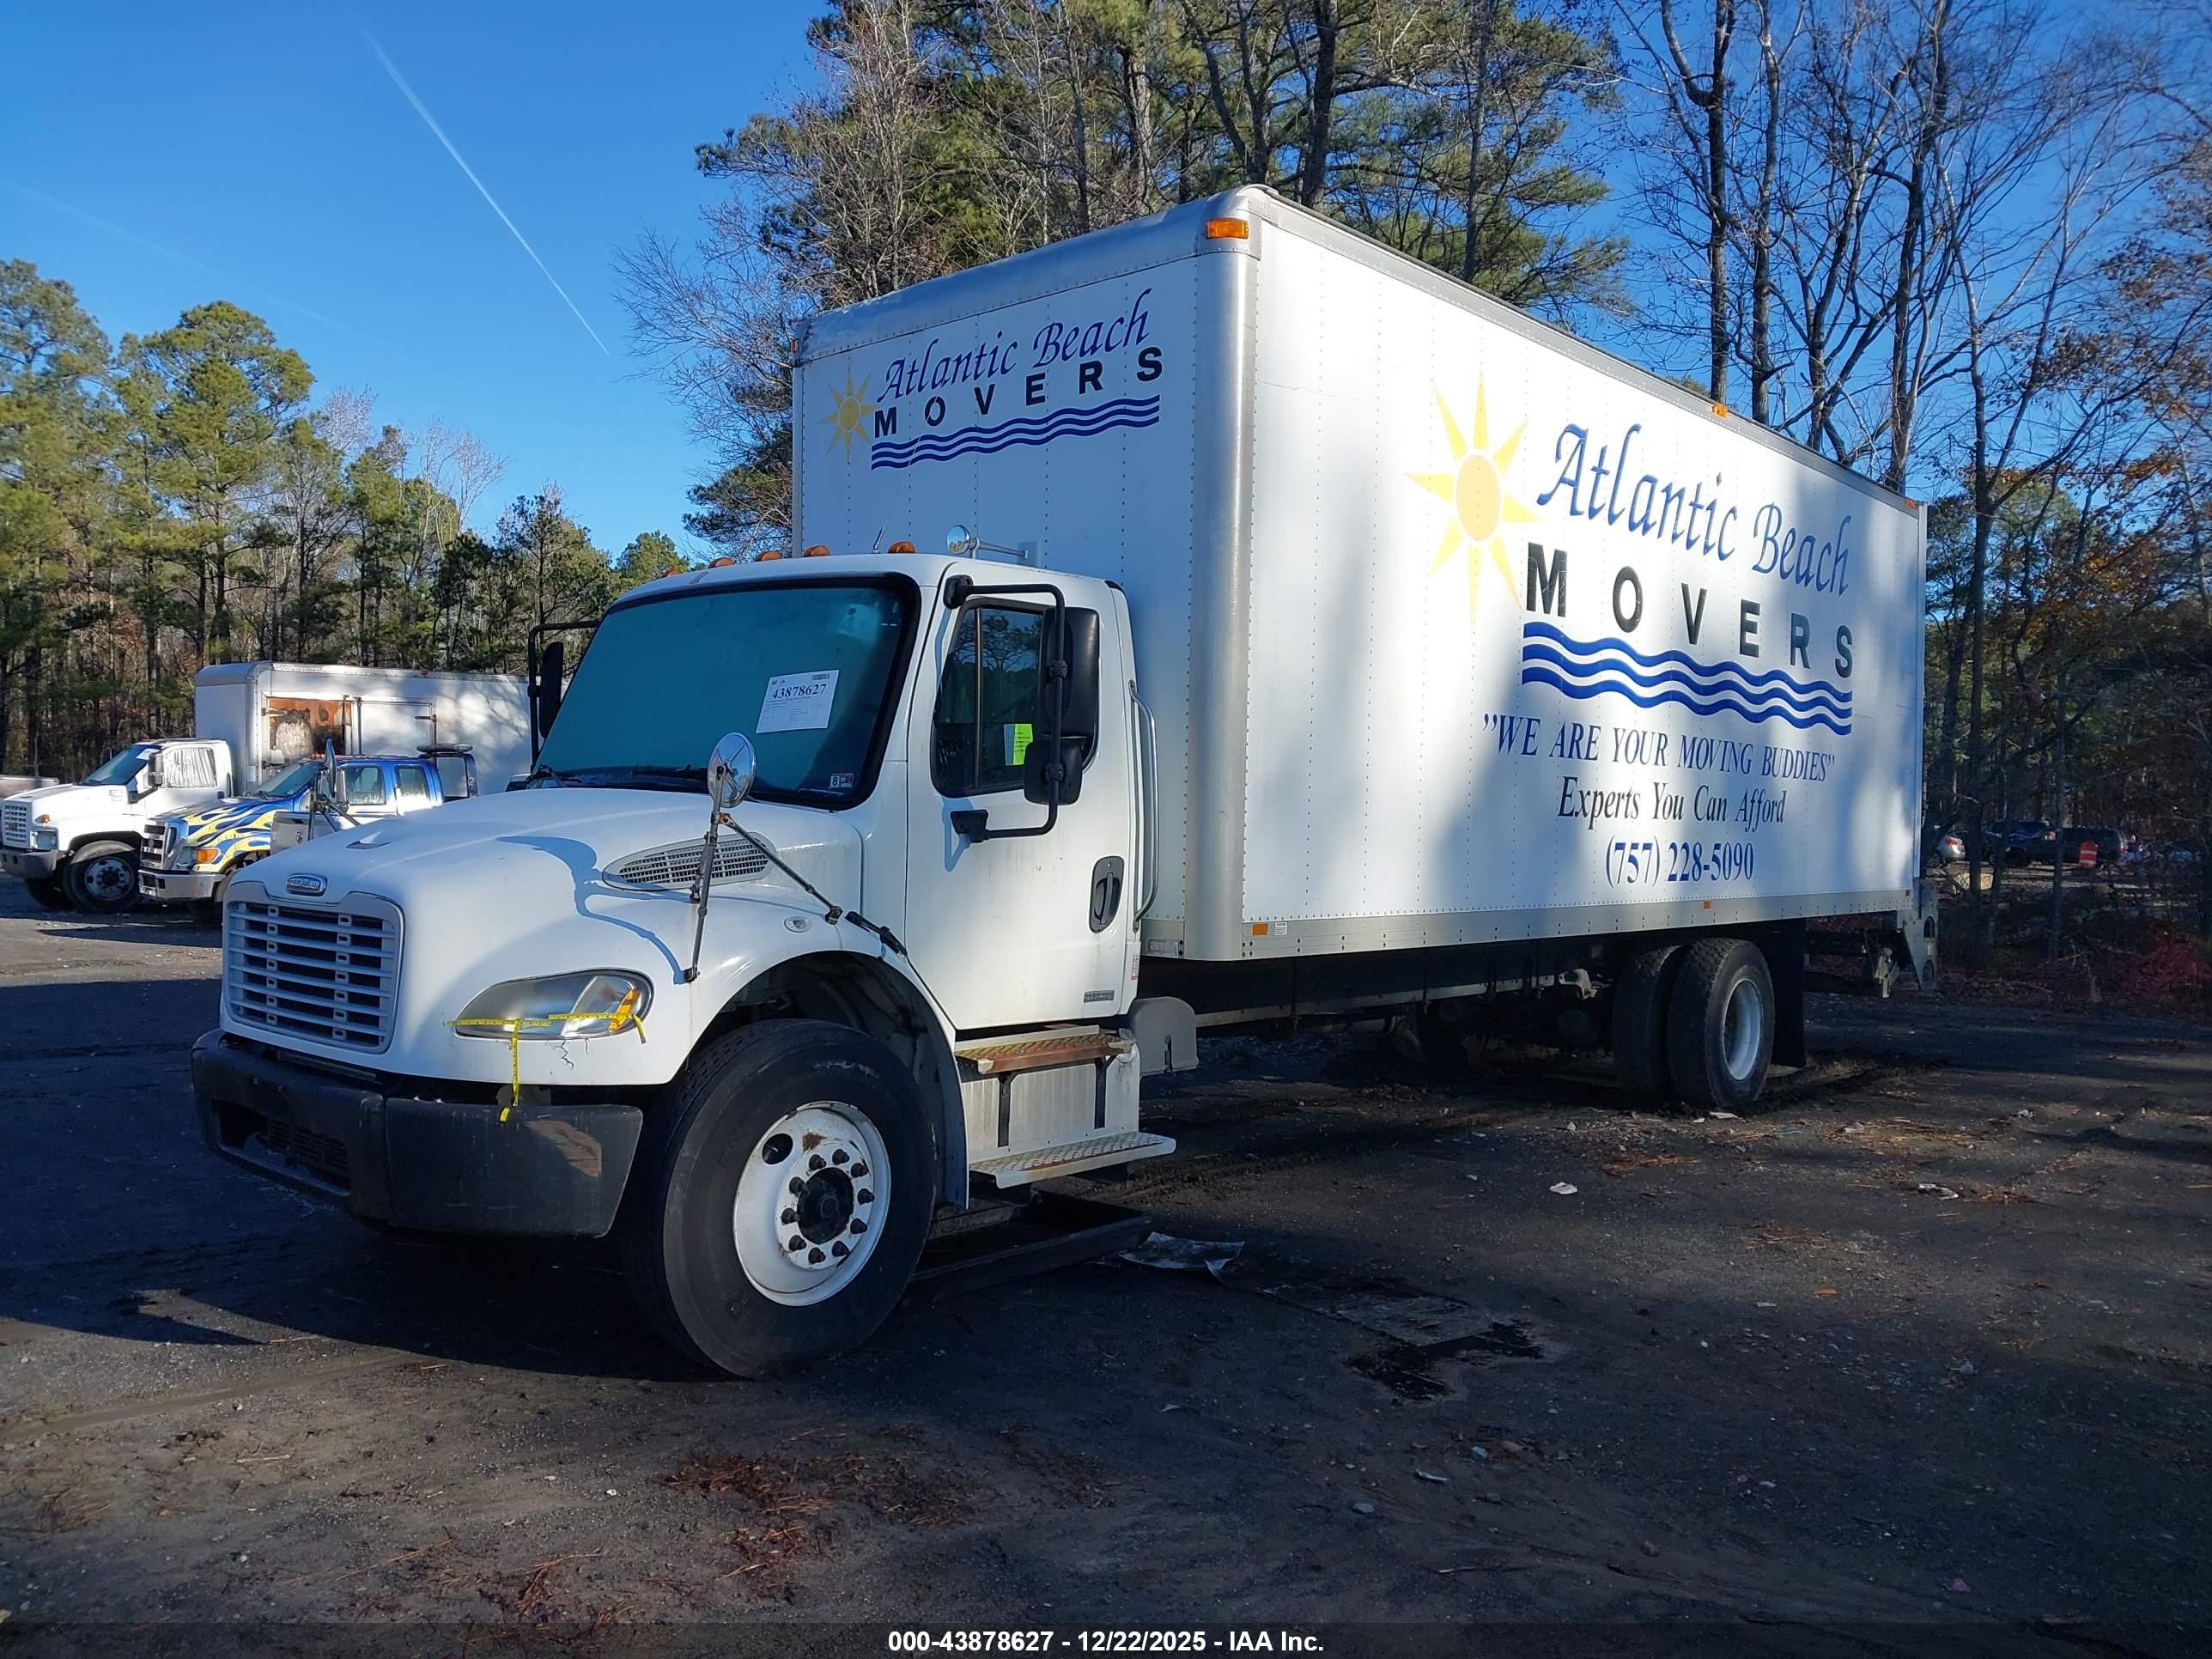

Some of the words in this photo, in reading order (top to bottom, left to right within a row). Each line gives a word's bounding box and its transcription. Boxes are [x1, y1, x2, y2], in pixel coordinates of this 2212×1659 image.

[877, 330, 1018, 403] Atlantic
[1031, 288, 1152, 369] Beach
[873, 346, 1163, 439] MOVERS
[1536, 423, 1738, 562] Atlantic
[1752, 501, 1852, 597] Beach
[1526, 541, 1853, 678] MOVERS
[771, 684, 827, 700] 43878627
[1549, 725, 1601, 762] ARE
[1611, 728, 1669, 768] YOUR
[1677, 734, 1753, 775] MOVING
[1557, 775, 1642, 830] Experts
[1652, 781, 1685, 820] You
[1693, 784, 1728, 823] Can
[1735, 788, 1787, 833] Afford
[1605, 835, 1661, 890] (757)
[1666, 842, 1754, 883] 228-5090
